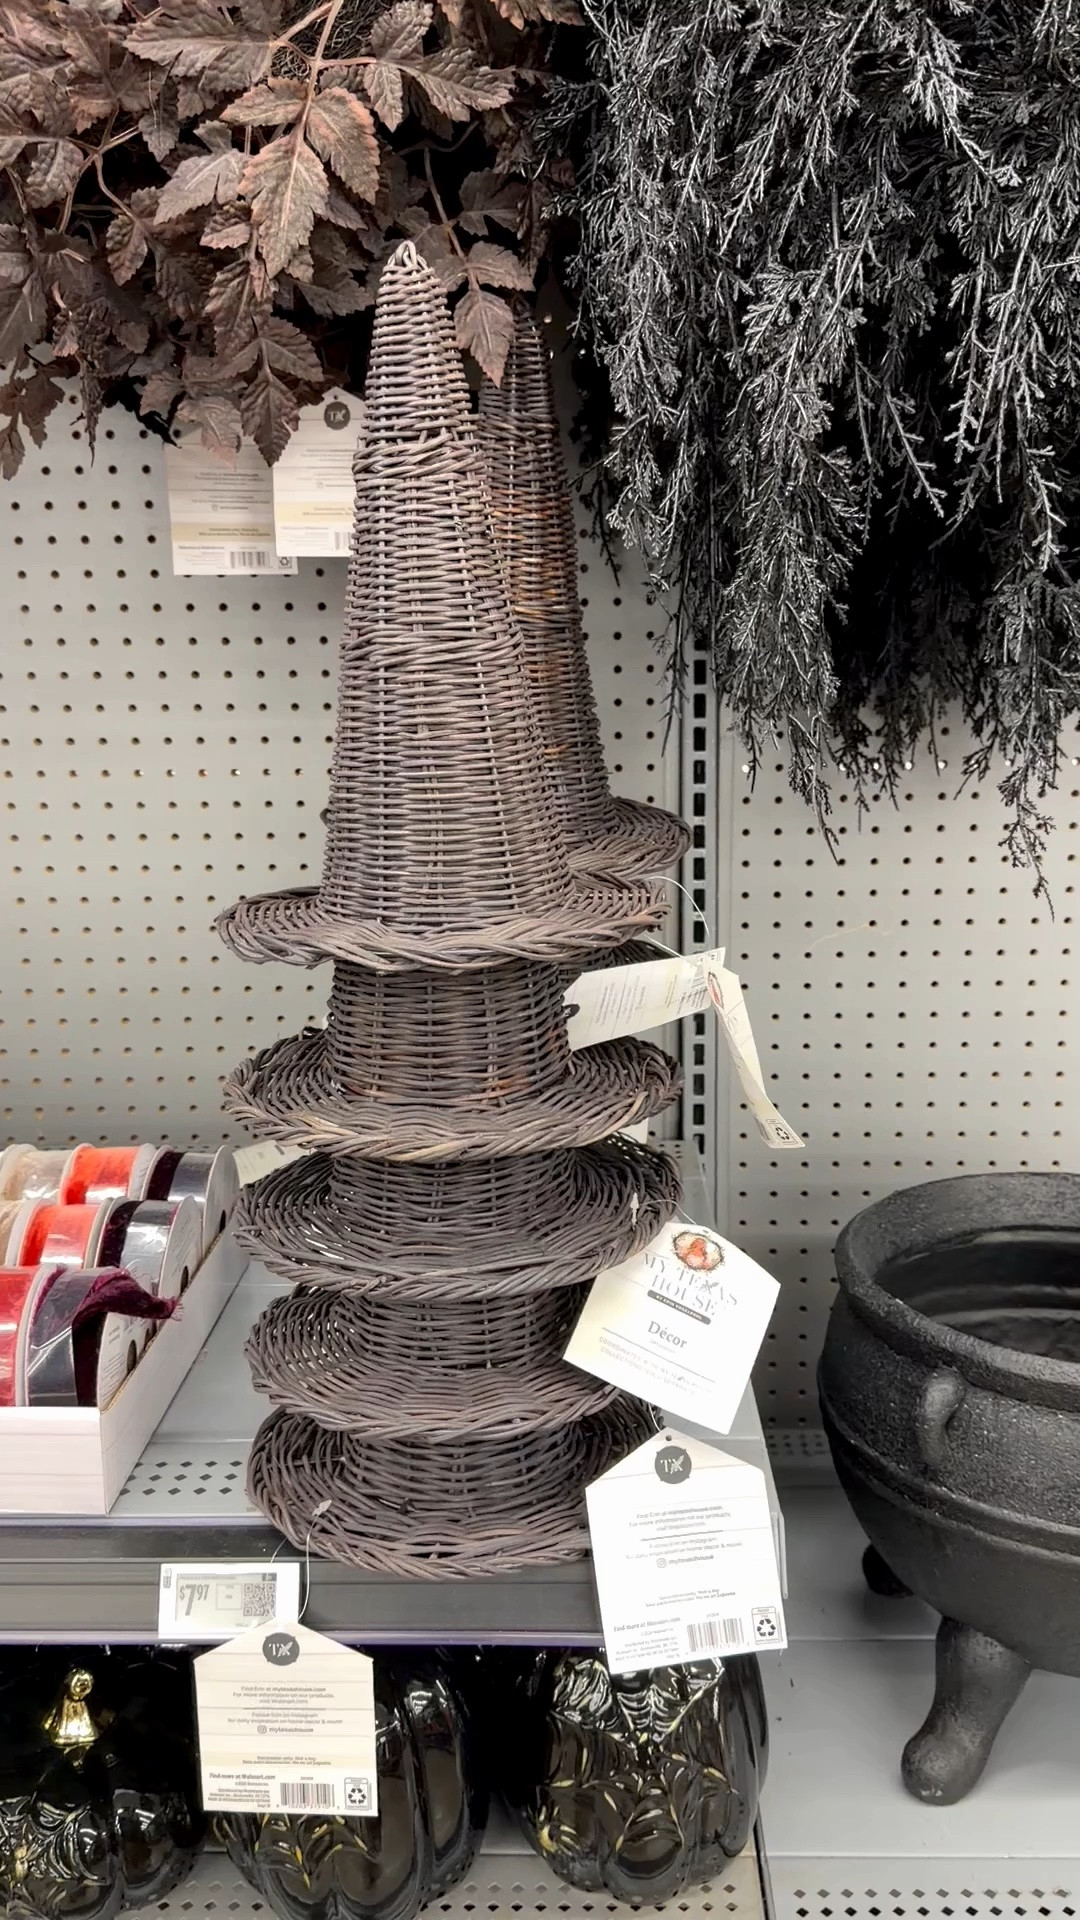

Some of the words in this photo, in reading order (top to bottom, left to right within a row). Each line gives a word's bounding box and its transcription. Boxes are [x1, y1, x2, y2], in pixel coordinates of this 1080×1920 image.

[652, 1274, 716, 1316] HOUSE
[647, 1320, 688, 1349] Décor
[660, 1455, 684, 1474] TX
[268, 1641, 293, 1657] TX
